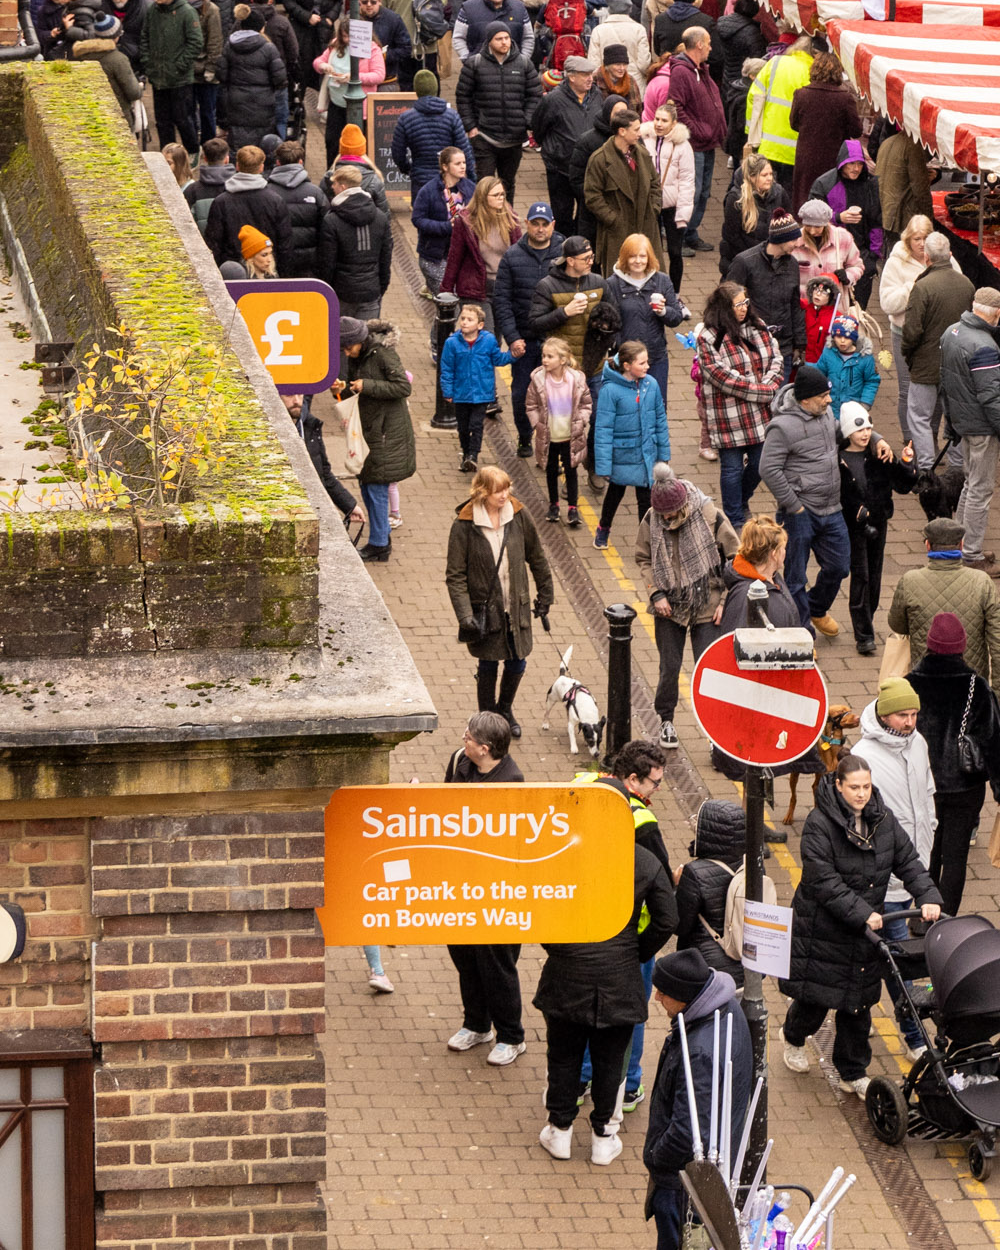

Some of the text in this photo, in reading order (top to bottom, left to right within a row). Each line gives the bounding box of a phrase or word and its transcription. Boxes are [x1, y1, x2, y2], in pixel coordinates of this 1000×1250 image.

[386, 171, 412, 183] CAKE
[261, 310, 303, 366] £
[362, 806, 570, 844] Sainsbury's
[362, 880, 577, 906] Car park to the rear
[362, 908, 532, 931] on Bowers Way
